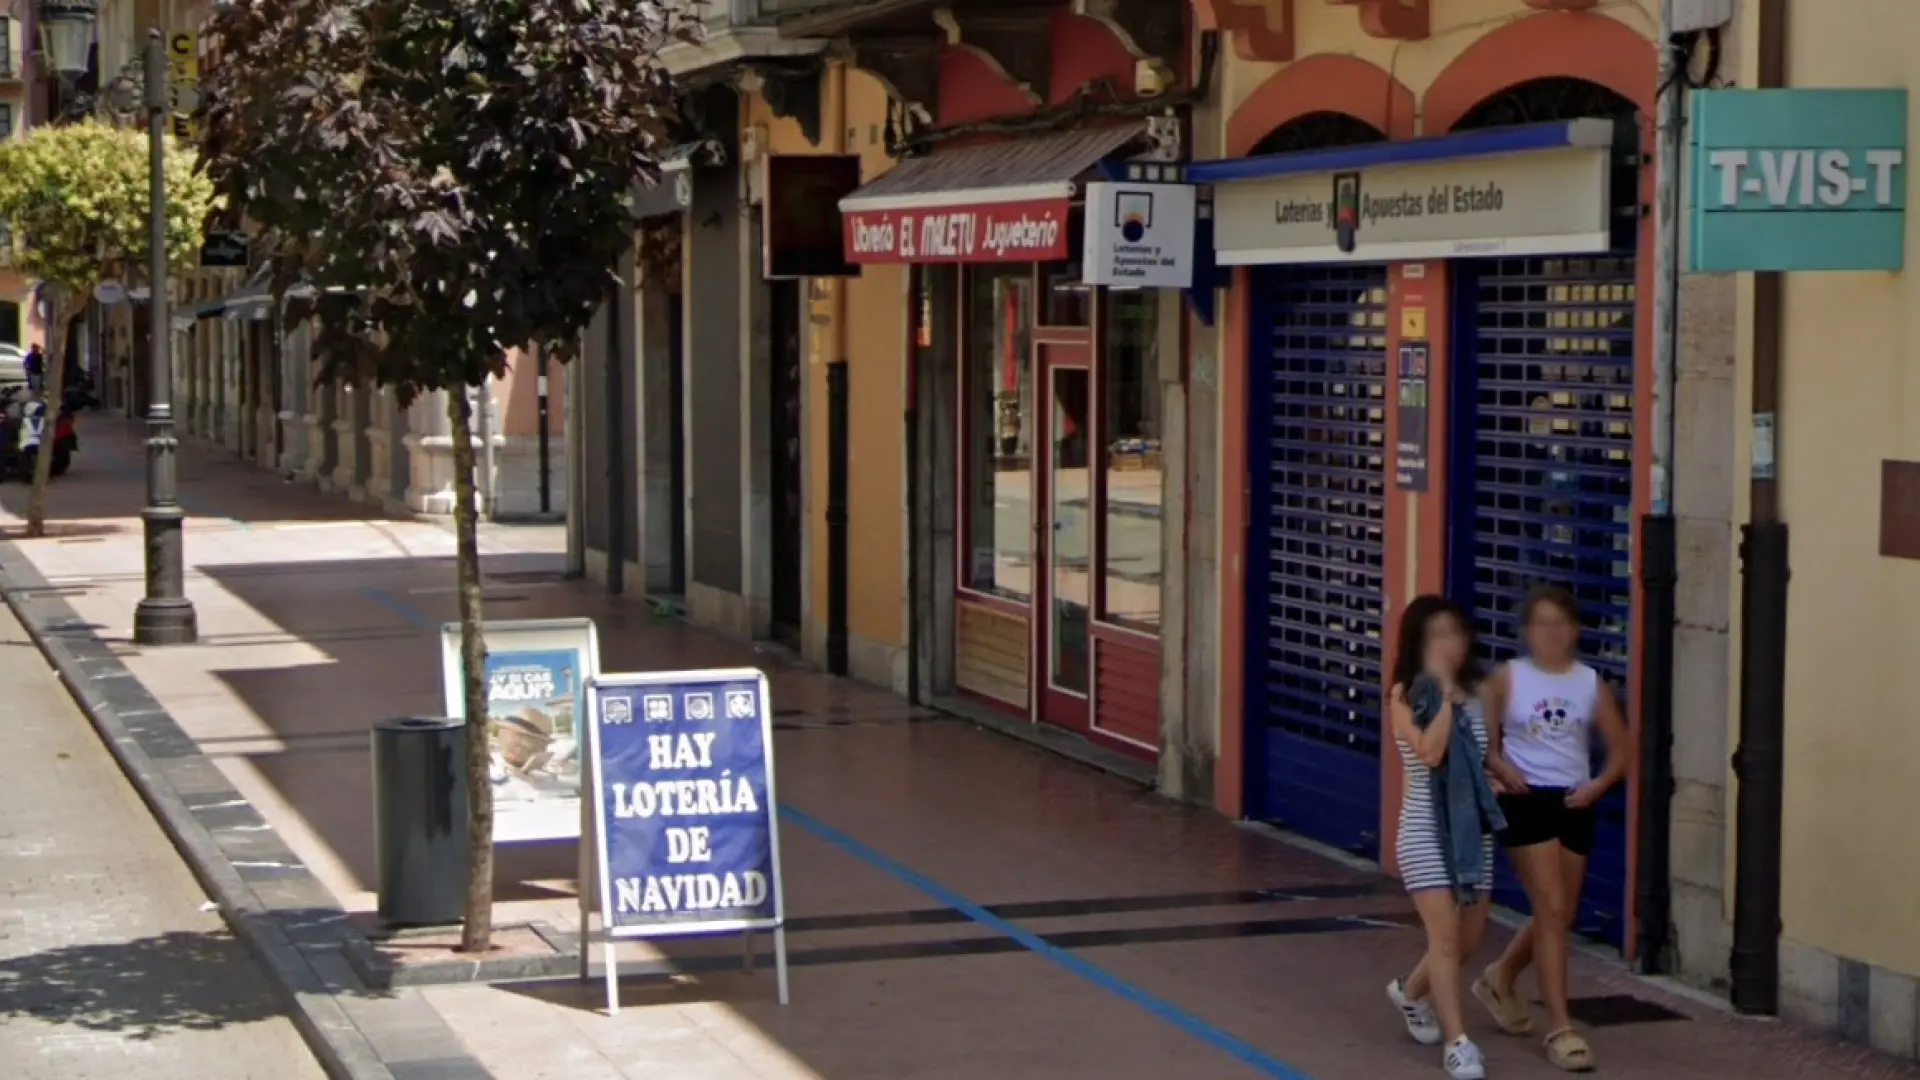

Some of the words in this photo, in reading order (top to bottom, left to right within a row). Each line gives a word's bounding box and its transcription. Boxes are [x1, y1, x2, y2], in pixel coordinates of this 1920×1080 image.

[1710, 149, 1902, 206] T-VIS-T
[1362, 189, 1423, 226] Apuestas
[1427, 184, 1448, 215] del
[1453, 180, 1503, 213] Estado
[900, 216, 915, 256] EL
[648, 733, 716, 769] HAY
[612, 768, 759, 819] LOTERÍA
[665, 825, 712, 863] DE
[614, 871, 767, 912] NAVIDAD
